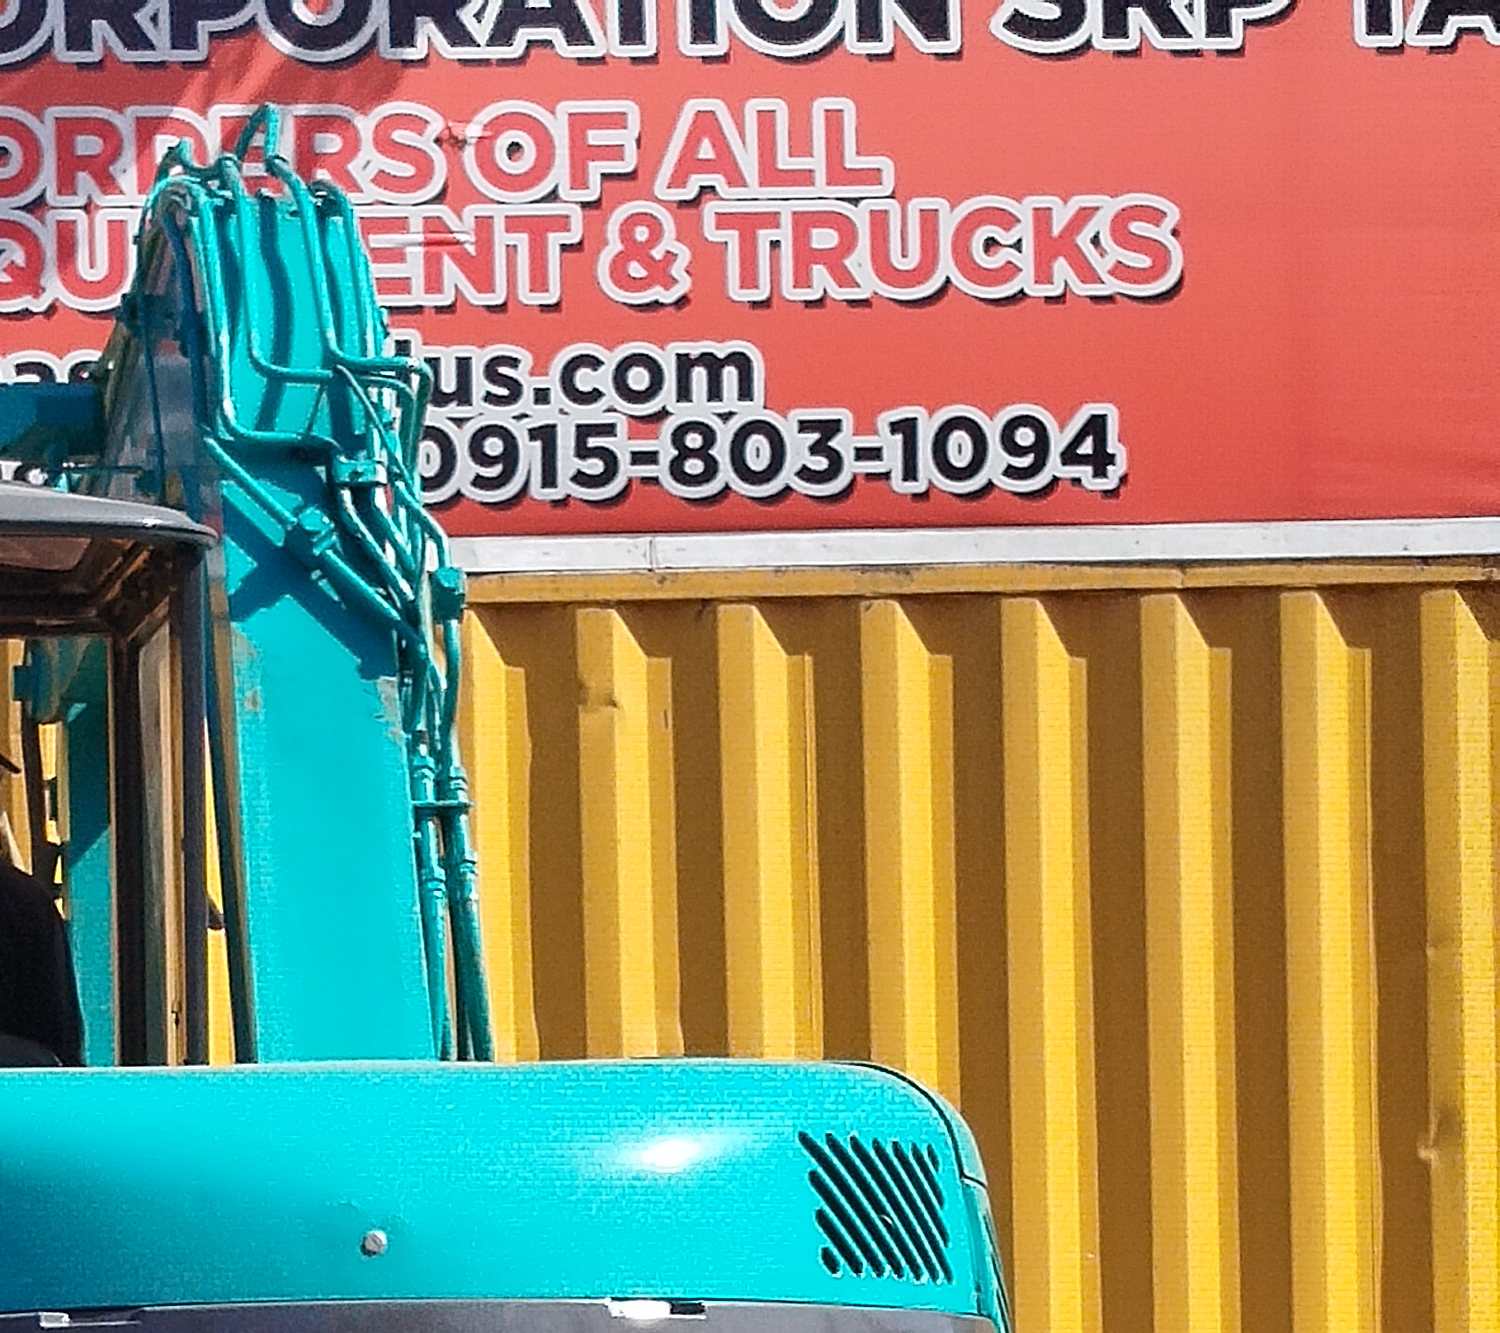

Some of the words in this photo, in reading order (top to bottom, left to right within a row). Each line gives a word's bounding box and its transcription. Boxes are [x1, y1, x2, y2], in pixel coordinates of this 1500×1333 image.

[468, 99, 640, 203] OF
[656, 98, 894, 200] ALL
[597, 200, 693, 305] &
[705, 194, 1184, 301] TRUCKS
[410, 403, 1127, 503] 0915-803-1094
